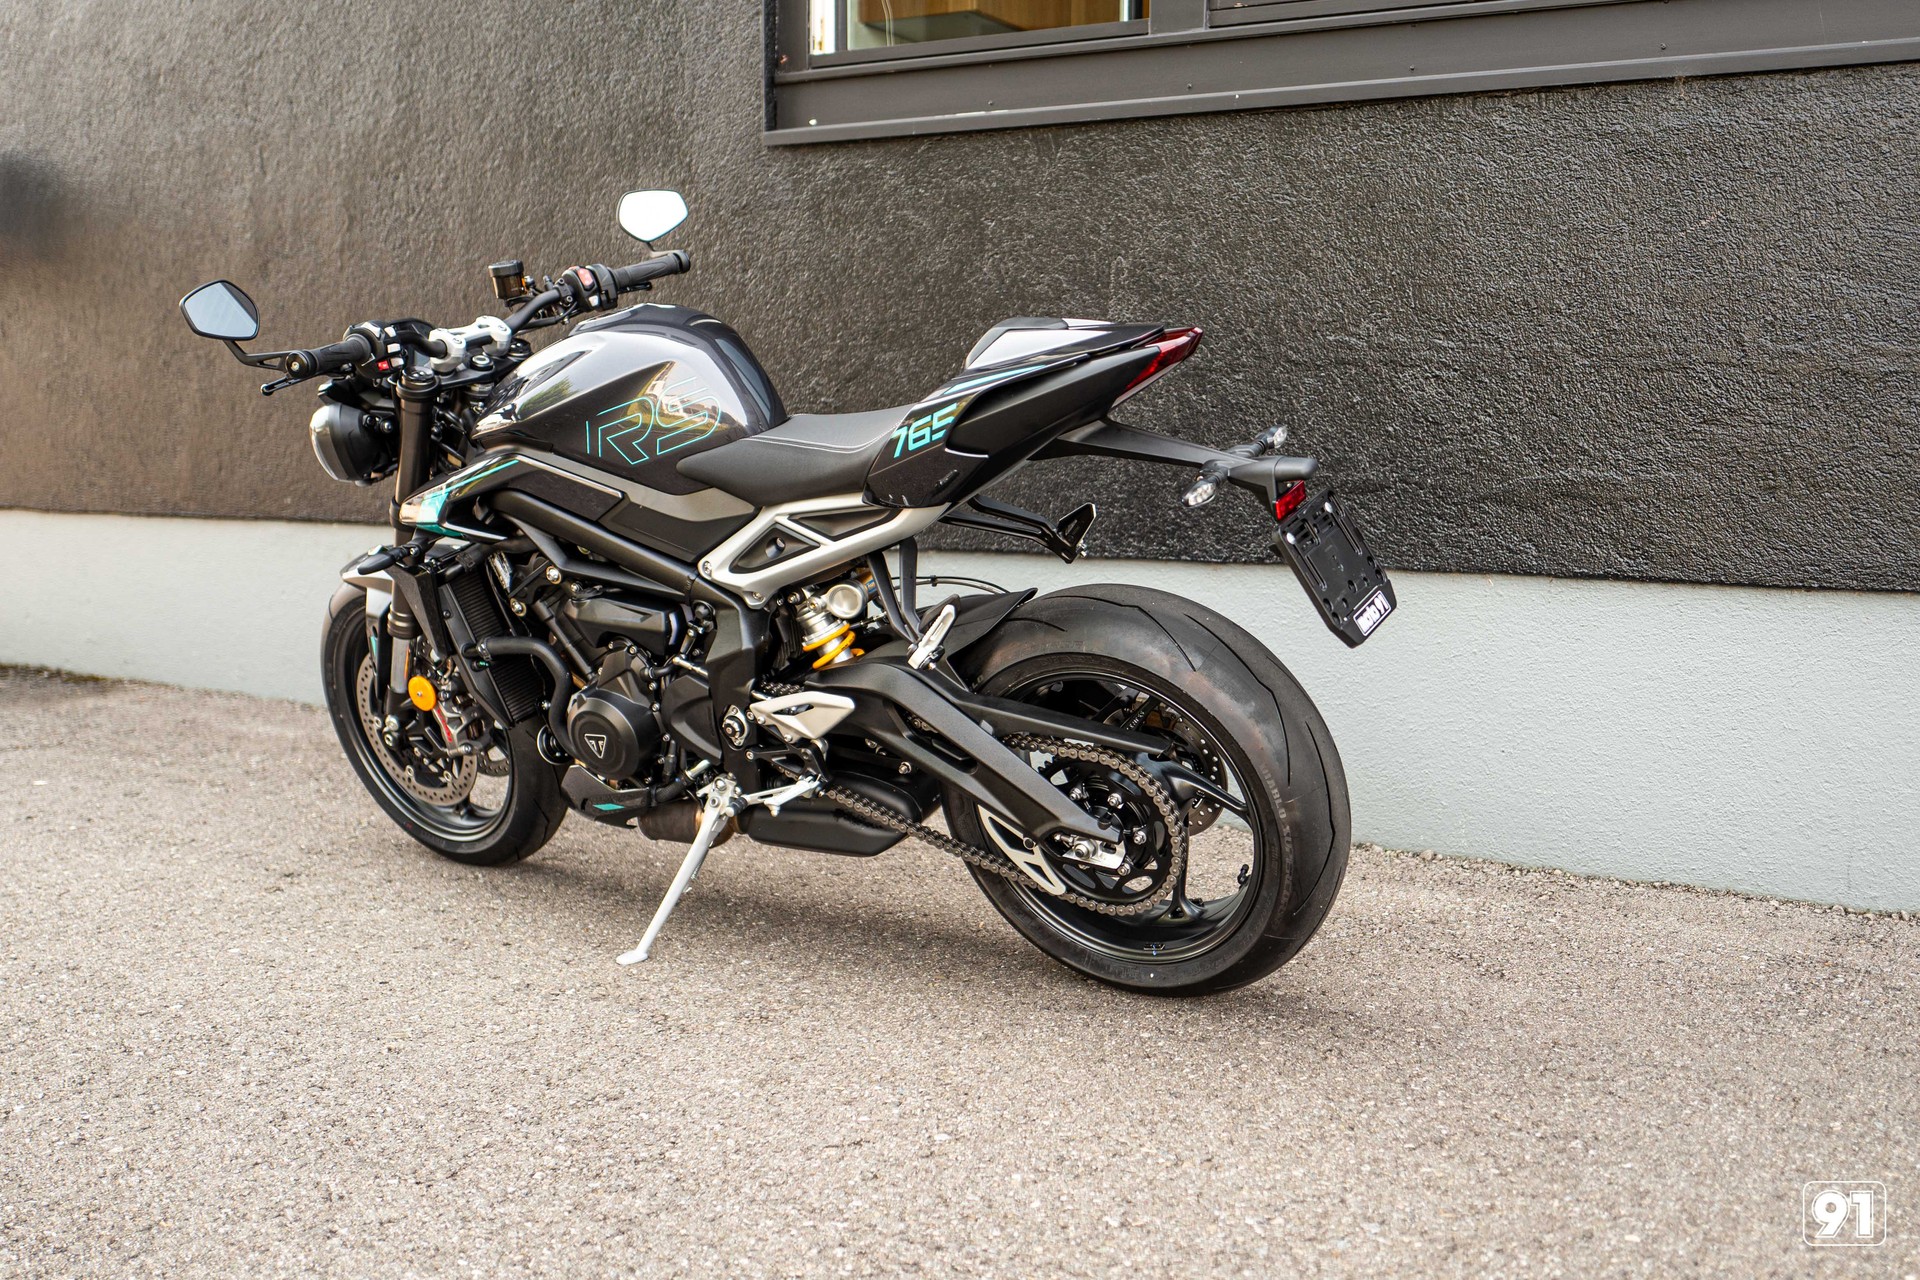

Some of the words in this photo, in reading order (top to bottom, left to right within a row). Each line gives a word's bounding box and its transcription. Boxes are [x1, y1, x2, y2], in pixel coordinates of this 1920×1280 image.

[585, 376, 722, 465] RS
[891, 402, 957, 459] 765
[1356, 604, 1381, 633] moto
[1374, 593, 1389, 615] 91
